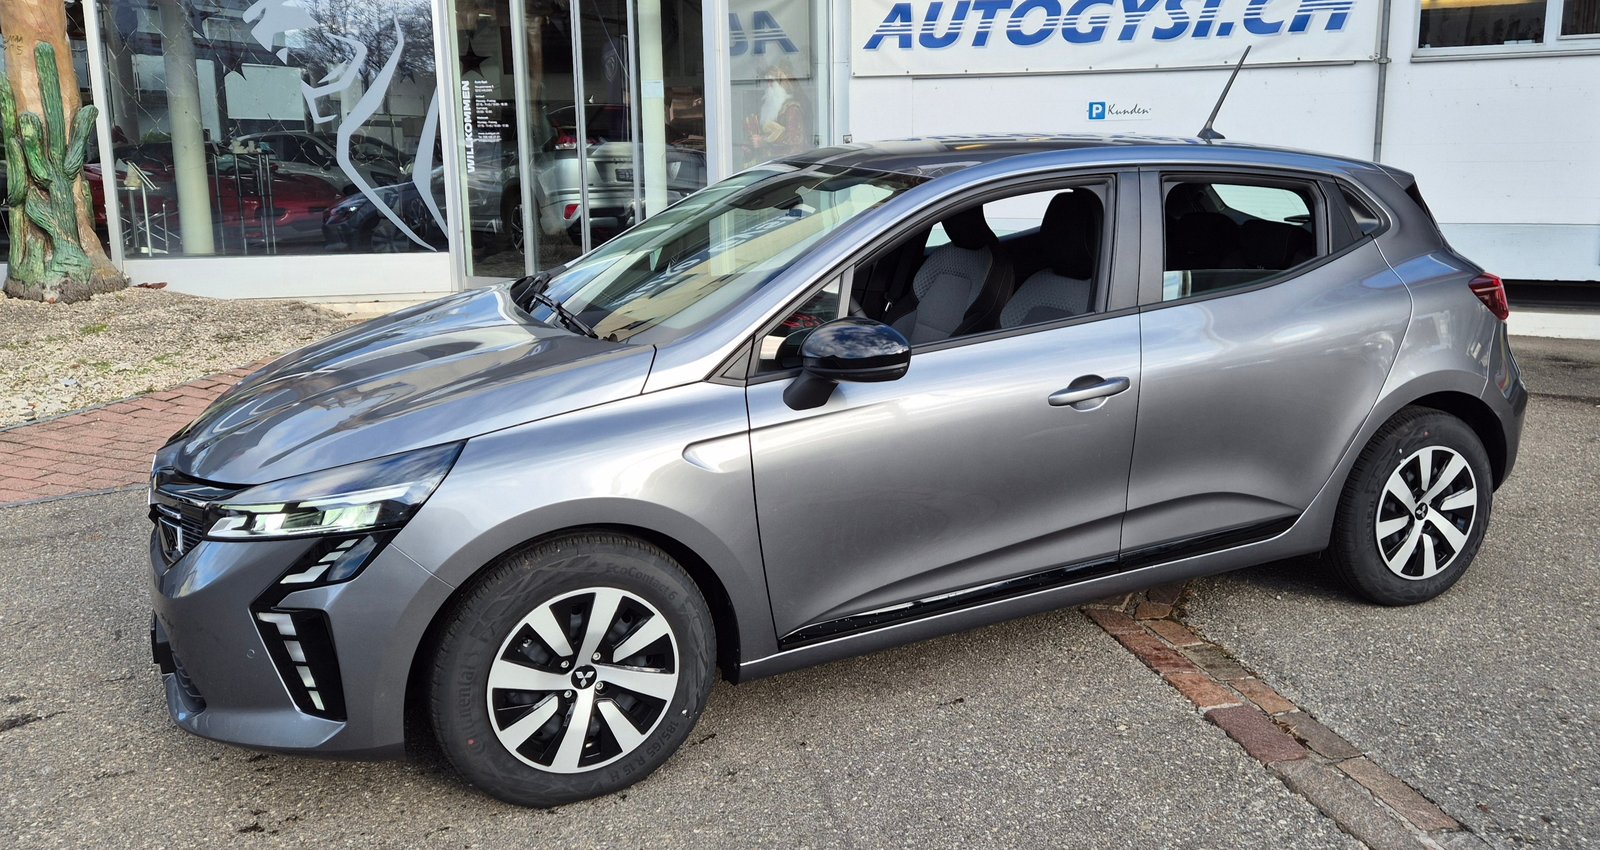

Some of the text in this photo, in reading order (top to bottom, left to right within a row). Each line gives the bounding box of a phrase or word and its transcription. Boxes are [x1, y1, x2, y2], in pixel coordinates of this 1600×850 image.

[862, 0, 1355, 50] AUTOGYSI.CH
[461, 80, 475, 173] WILLKOMMEN
[1091, 103, 1150, 118] P Kunden
[646, 721, 680, 758] 185/65
[634, 755, 647, 767] R
